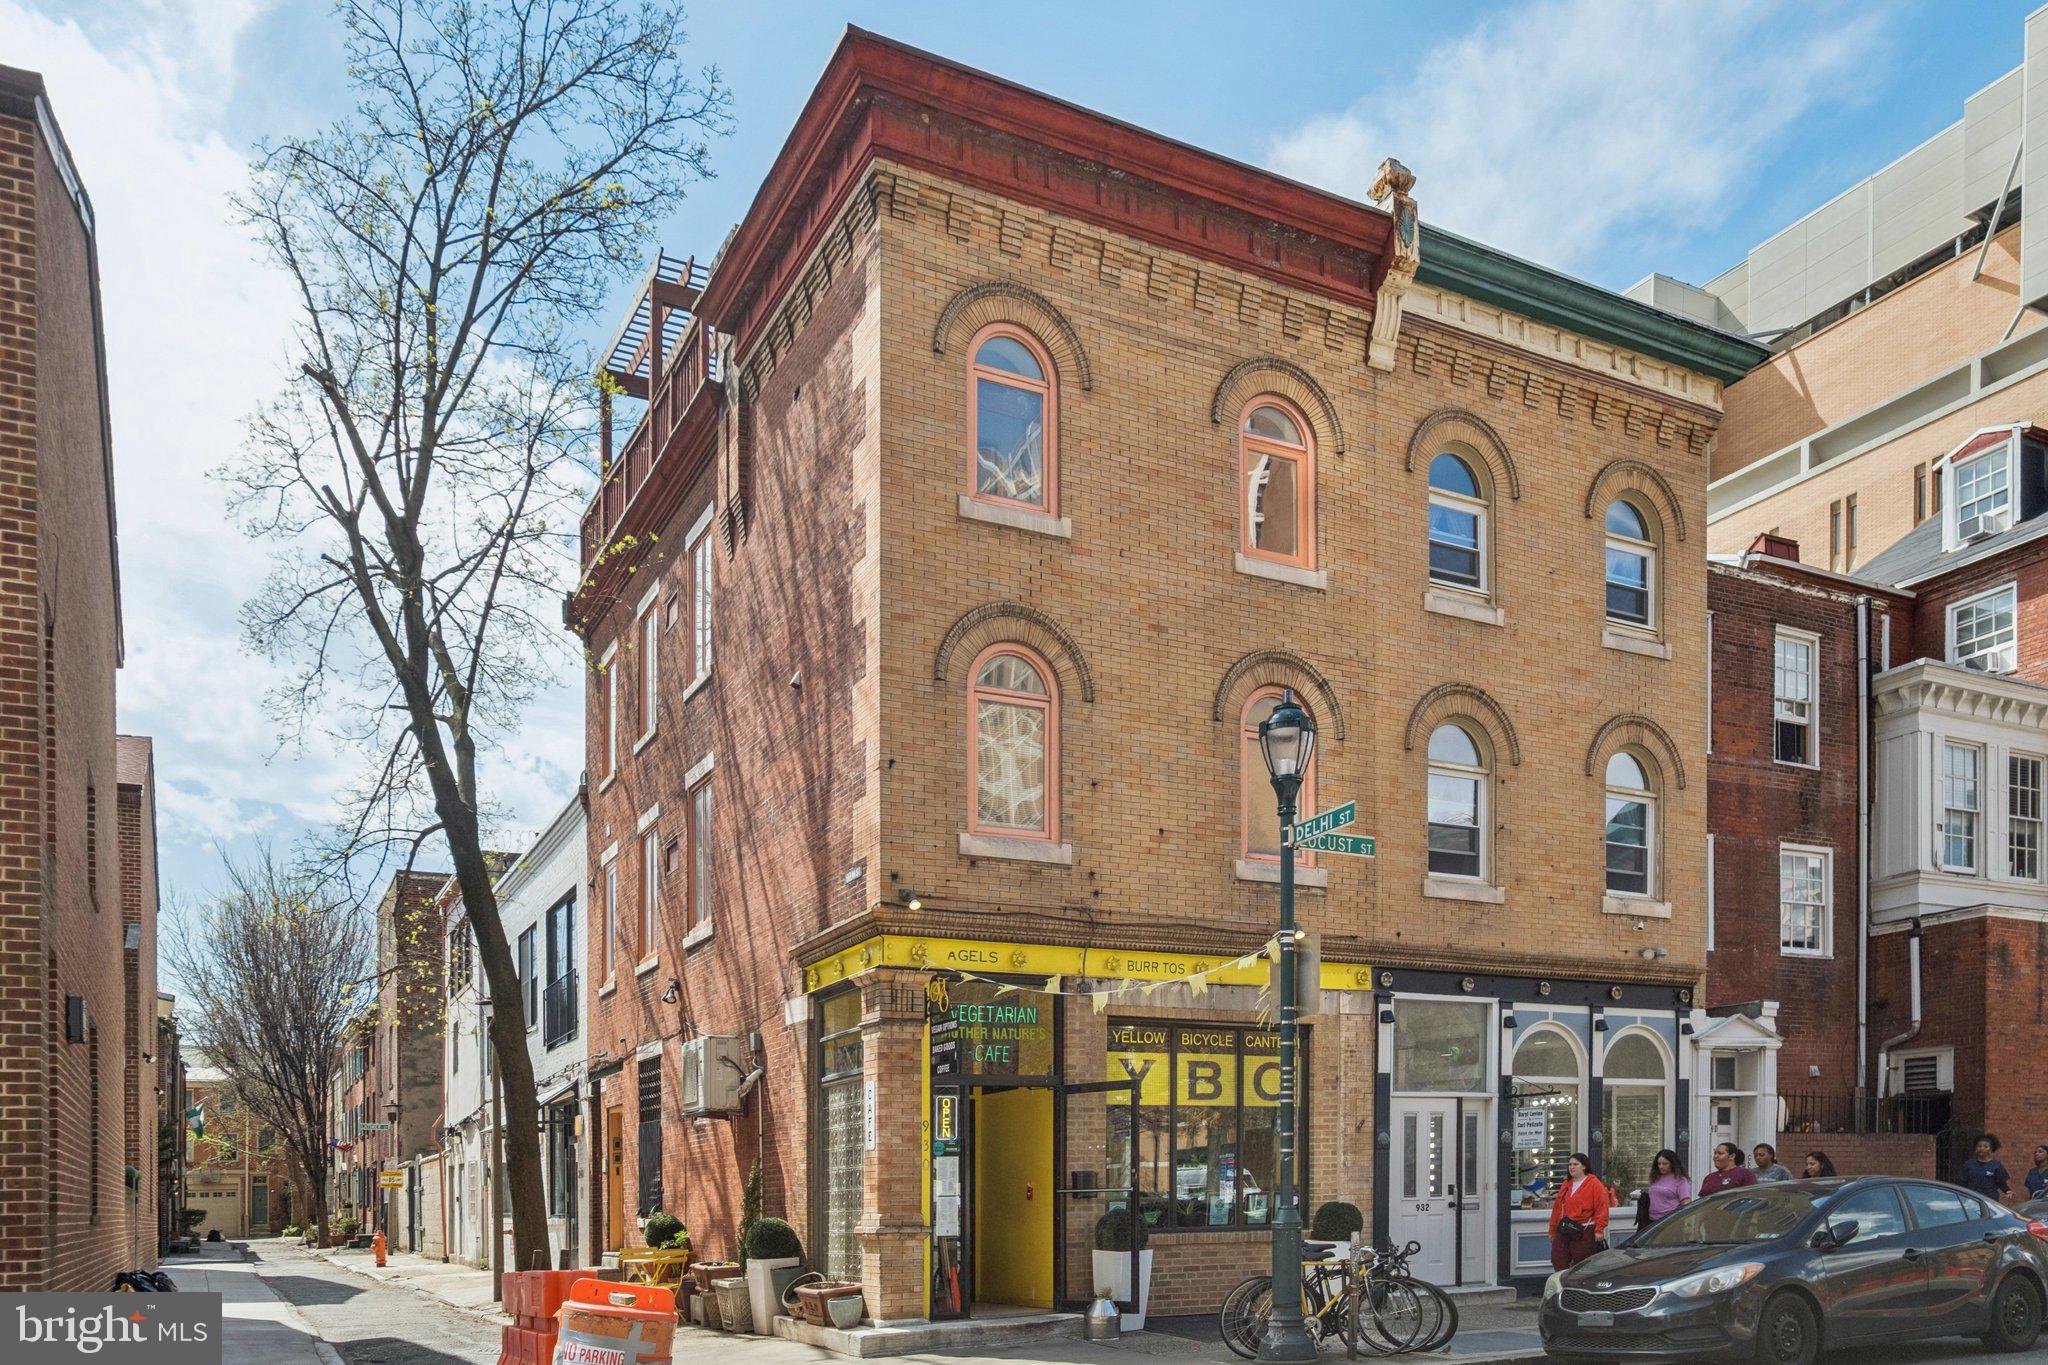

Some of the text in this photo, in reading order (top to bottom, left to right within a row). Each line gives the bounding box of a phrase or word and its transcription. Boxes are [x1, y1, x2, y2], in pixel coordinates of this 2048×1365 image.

[1296, 810, 1351, 842] DELHI ST
[1360, 843, 1372, 855] ST
[950, 1004, 1037, 1023] VEGETARIAN
[943, 1020, 957, 1031] OPTIONS
[992, 1026, 1047, 1041] NATURE'S
[1112, 1029, 1167, 1044] YELLOW
[1181, 1033, 1233, 1047] BICYCLE
[974, 1044, 1011, 1063] CAFE
[942, 1098, 951, 1138] OPEN
[1415, 1203, 1430, 1212] 932
[579, 1348, 626, 1365] PARKING
